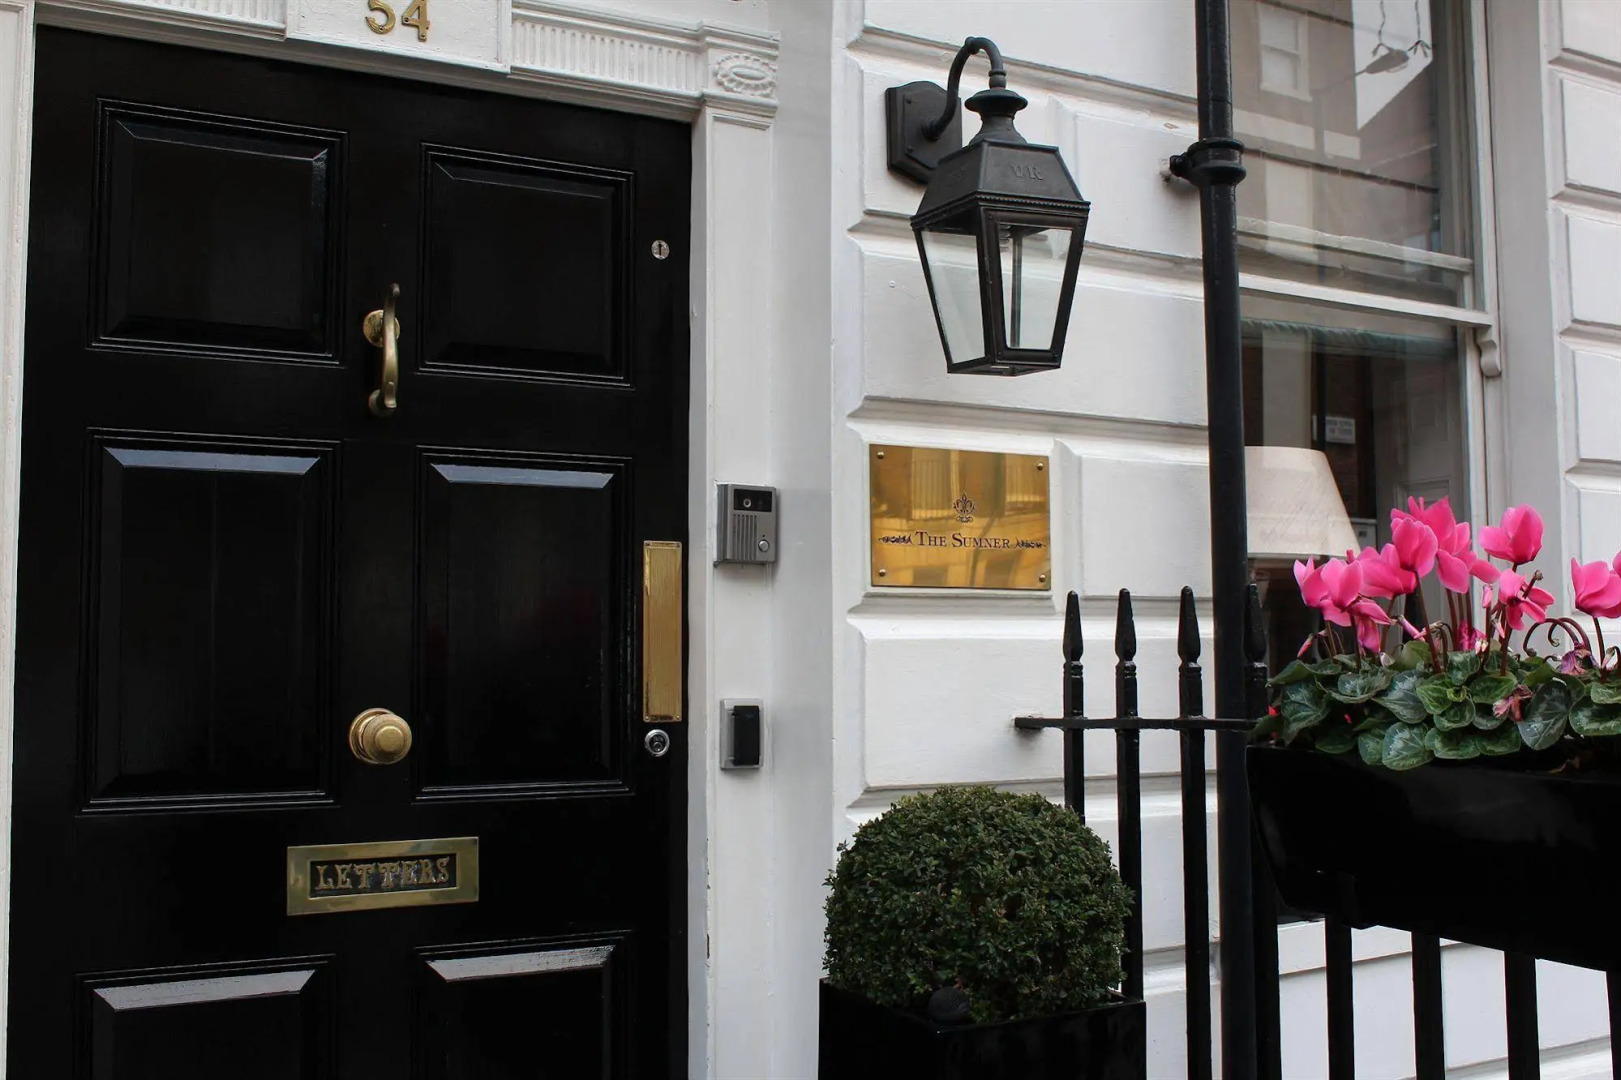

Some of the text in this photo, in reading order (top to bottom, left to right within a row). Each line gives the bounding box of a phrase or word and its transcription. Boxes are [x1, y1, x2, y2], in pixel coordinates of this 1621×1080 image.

[365, 0, 430, 42] 54
[1011, 163, 1044, 181] VR
[914, 530, 1010, 549] THE SUMNER
[315, 857, 450, 890] LETTERS
